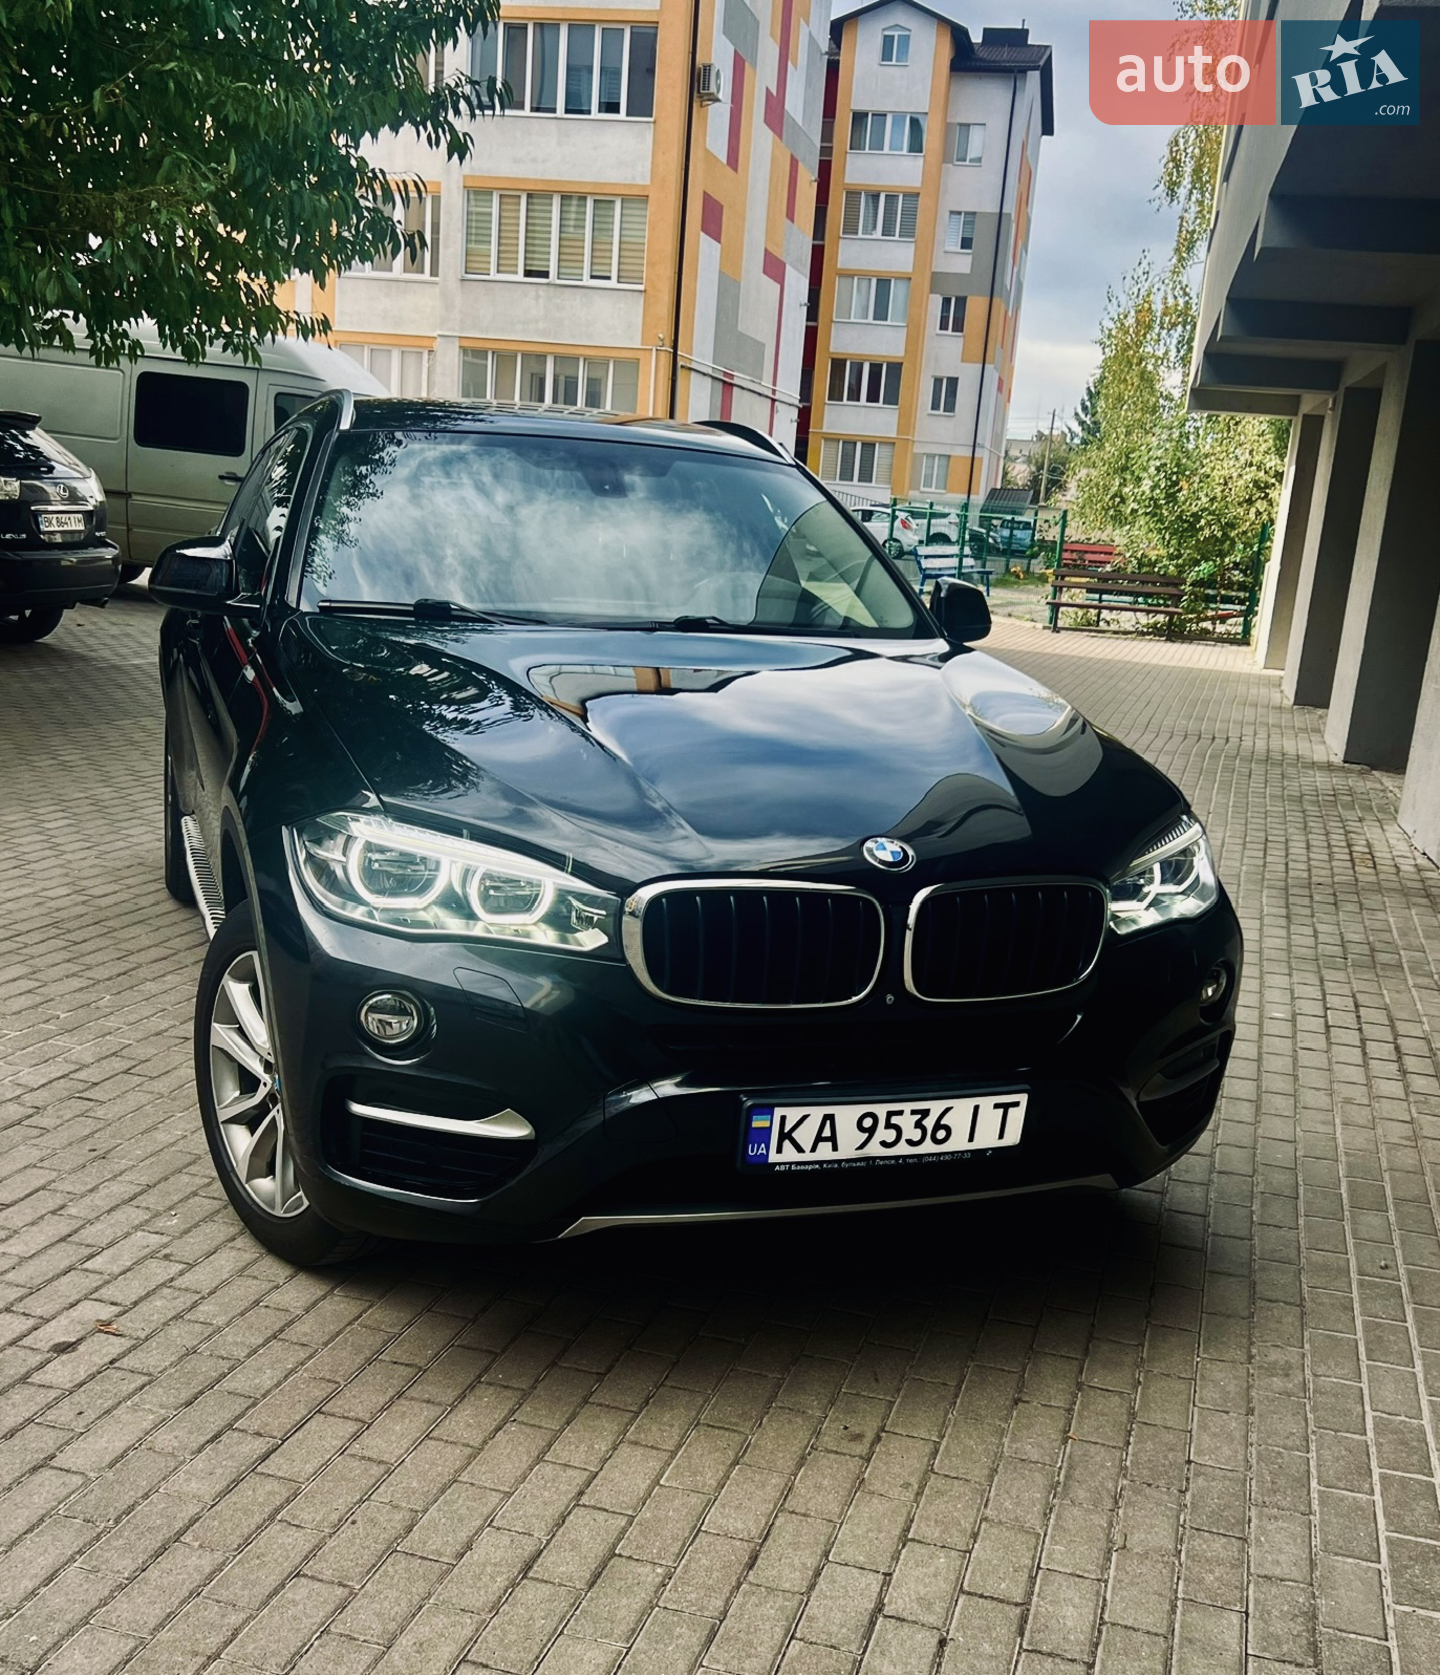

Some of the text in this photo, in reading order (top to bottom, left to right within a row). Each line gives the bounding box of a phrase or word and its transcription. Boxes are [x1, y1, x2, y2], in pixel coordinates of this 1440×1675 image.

[43, 516, 55, 528] BK
[56, 516, 72, 528] 8641
[775, 1101, 1021, 1155] KA 9536 IT
[748, 1142, 767, 1156] UA
